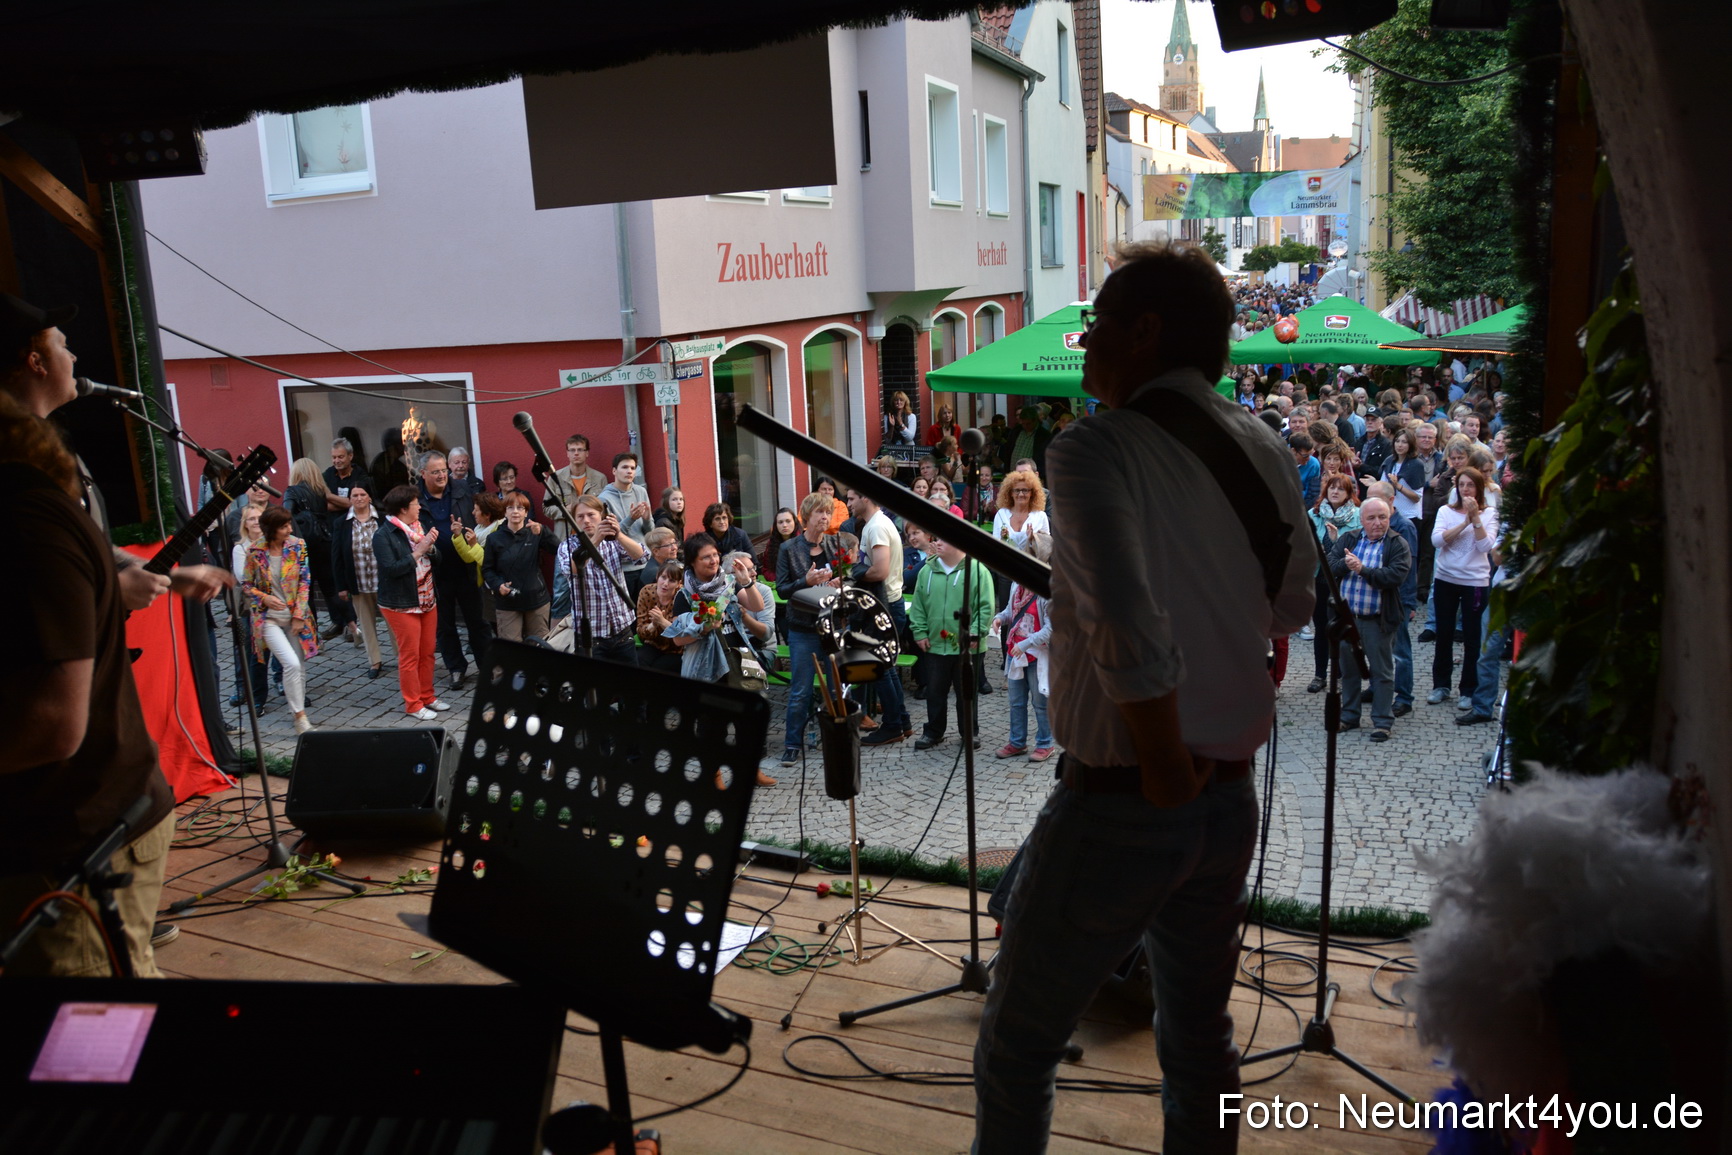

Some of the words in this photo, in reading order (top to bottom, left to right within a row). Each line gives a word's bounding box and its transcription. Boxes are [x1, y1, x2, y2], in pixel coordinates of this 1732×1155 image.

[717, 241, 828, 283] Zauberhaft
[977, 241, 1007, 267] berhaft
[676, 365, 702, 378] stergasse
[1022, 362, 1083, 371] Lamm
